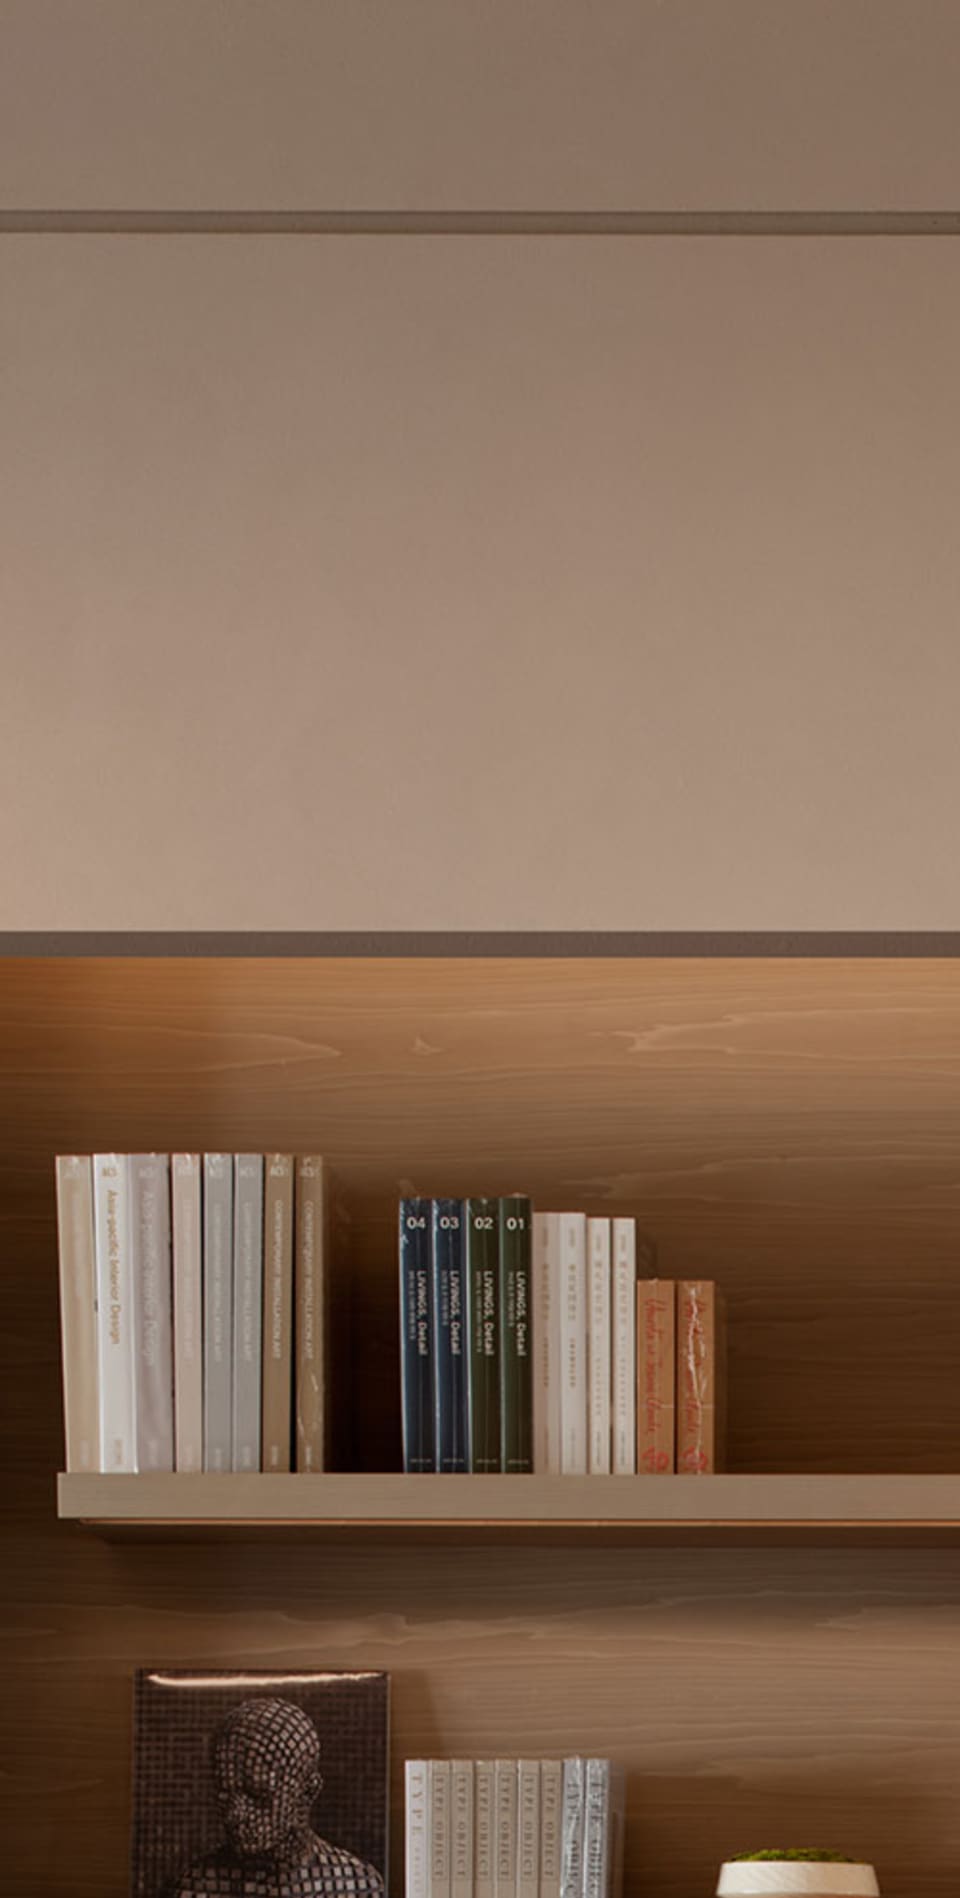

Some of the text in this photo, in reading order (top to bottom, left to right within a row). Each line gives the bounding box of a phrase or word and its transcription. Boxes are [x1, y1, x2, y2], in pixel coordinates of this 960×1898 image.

[406, 1216, 426, 1229] 04
[440, 1216, 460, 1229] 03
[474, 1216, 494, 1229] 02
[506, 1216, 525, 1230] 01
